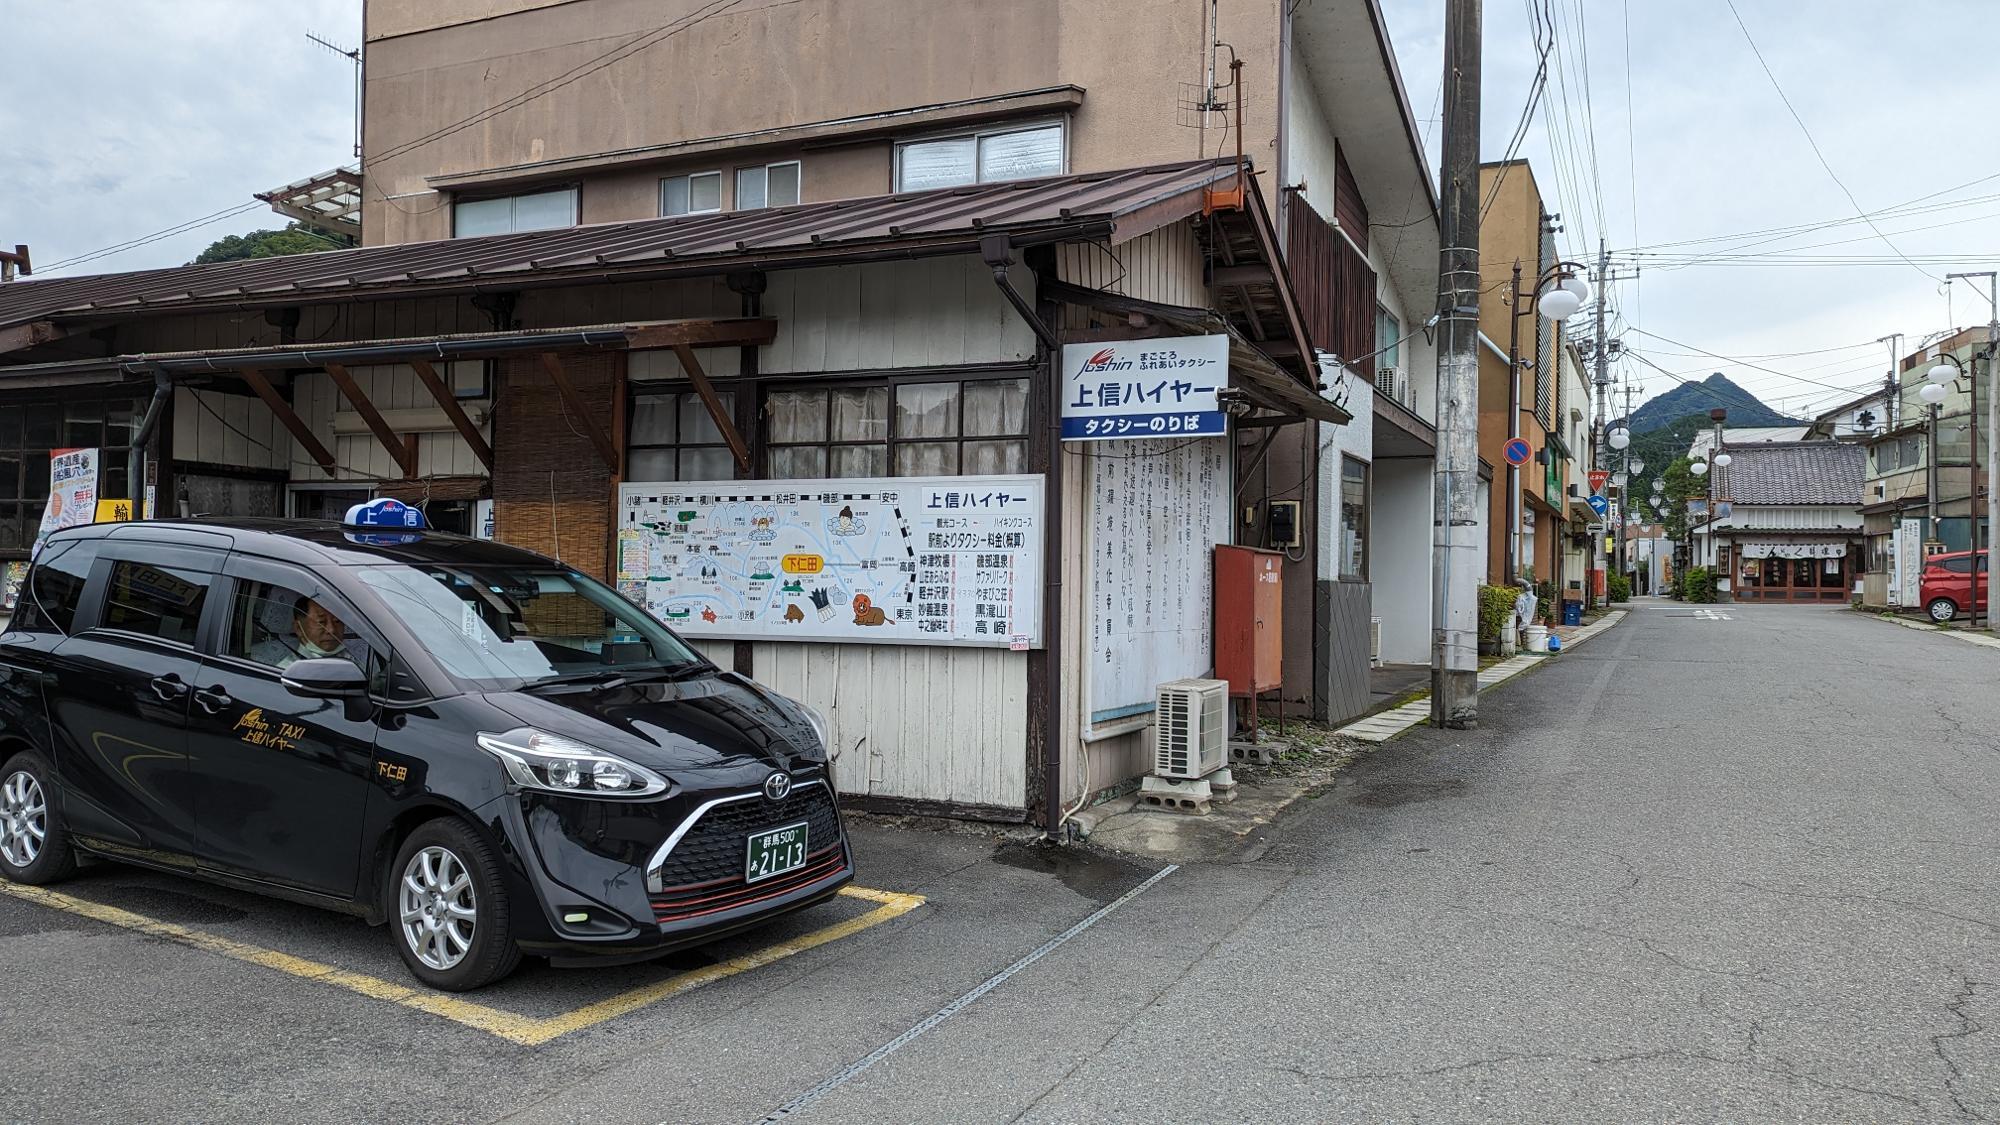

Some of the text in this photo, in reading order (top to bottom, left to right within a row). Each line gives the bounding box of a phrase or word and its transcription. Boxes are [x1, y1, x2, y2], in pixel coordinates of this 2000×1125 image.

[1140, 351, 1177, 361] まごころ
[1139, 359, 1216, 371] ふれあいタクシー
[1070, 379, 1215, 408] 上信ハイヤー
[1085, 414, 1200, 435] タクシーのりば
[776, 493, 796, 504] 松井田
[882, 492, 898, 503] 安中
[927, 492, 1027, 509] 上信ハイヤー
[936, 518, 968, 529] 観光コース
[994, 517, 1033, 528] ハイキングコース
[787, 557, 818, 571] 下仁田
[861, 560, 878, 570] 富岡
[899, 561, 916, 573] 高崎
[976, 554, 1008, 569] 磯部温泉
[976, 571, 1008, 585] サファリパーク
[919, 586, 949, 600] 軽井沢駅
[976, 587, 1007, 602] やまびこ荘
[896, 609, 913, 620] 東京
[918, 603, 949, 617] 妙義温泉
[975, 620, 1007, 635] 高崎
[278, 722, 306, 740] TAXI
[241, 729, 296, 750] 上信ハイヤー
[378, 761, 408, 781] 下仁田
[760, 842, 803, 875] 21-13
